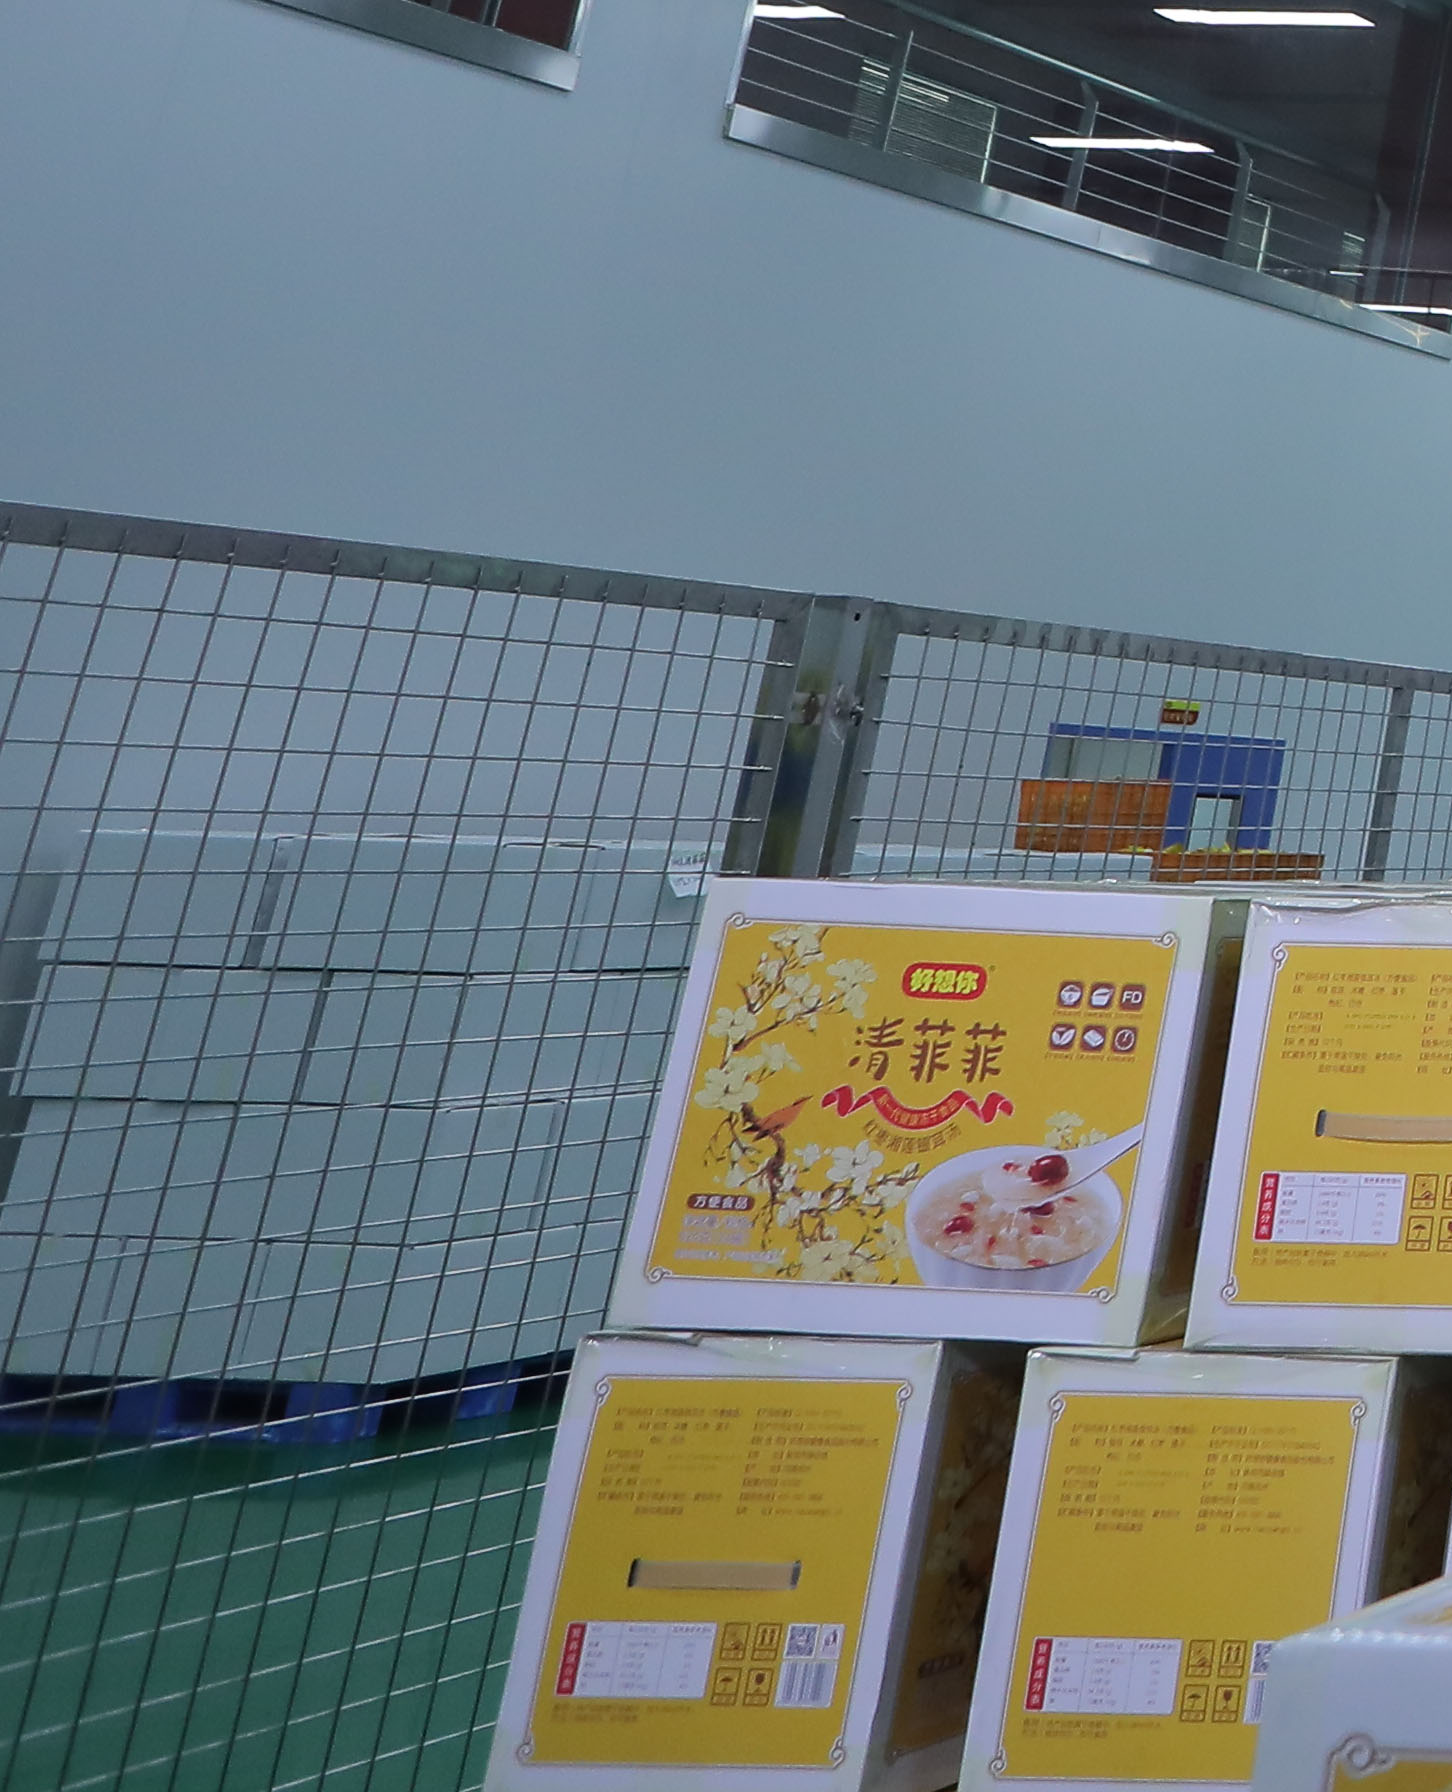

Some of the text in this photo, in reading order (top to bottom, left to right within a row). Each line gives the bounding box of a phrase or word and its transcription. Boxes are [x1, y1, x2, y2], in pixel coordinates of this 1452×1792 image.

[910, 968, 980, 994] 好想你
[1121, 991, 1142, 1005] FD
[848, 1016, 1007, 1084] 清菲菲
